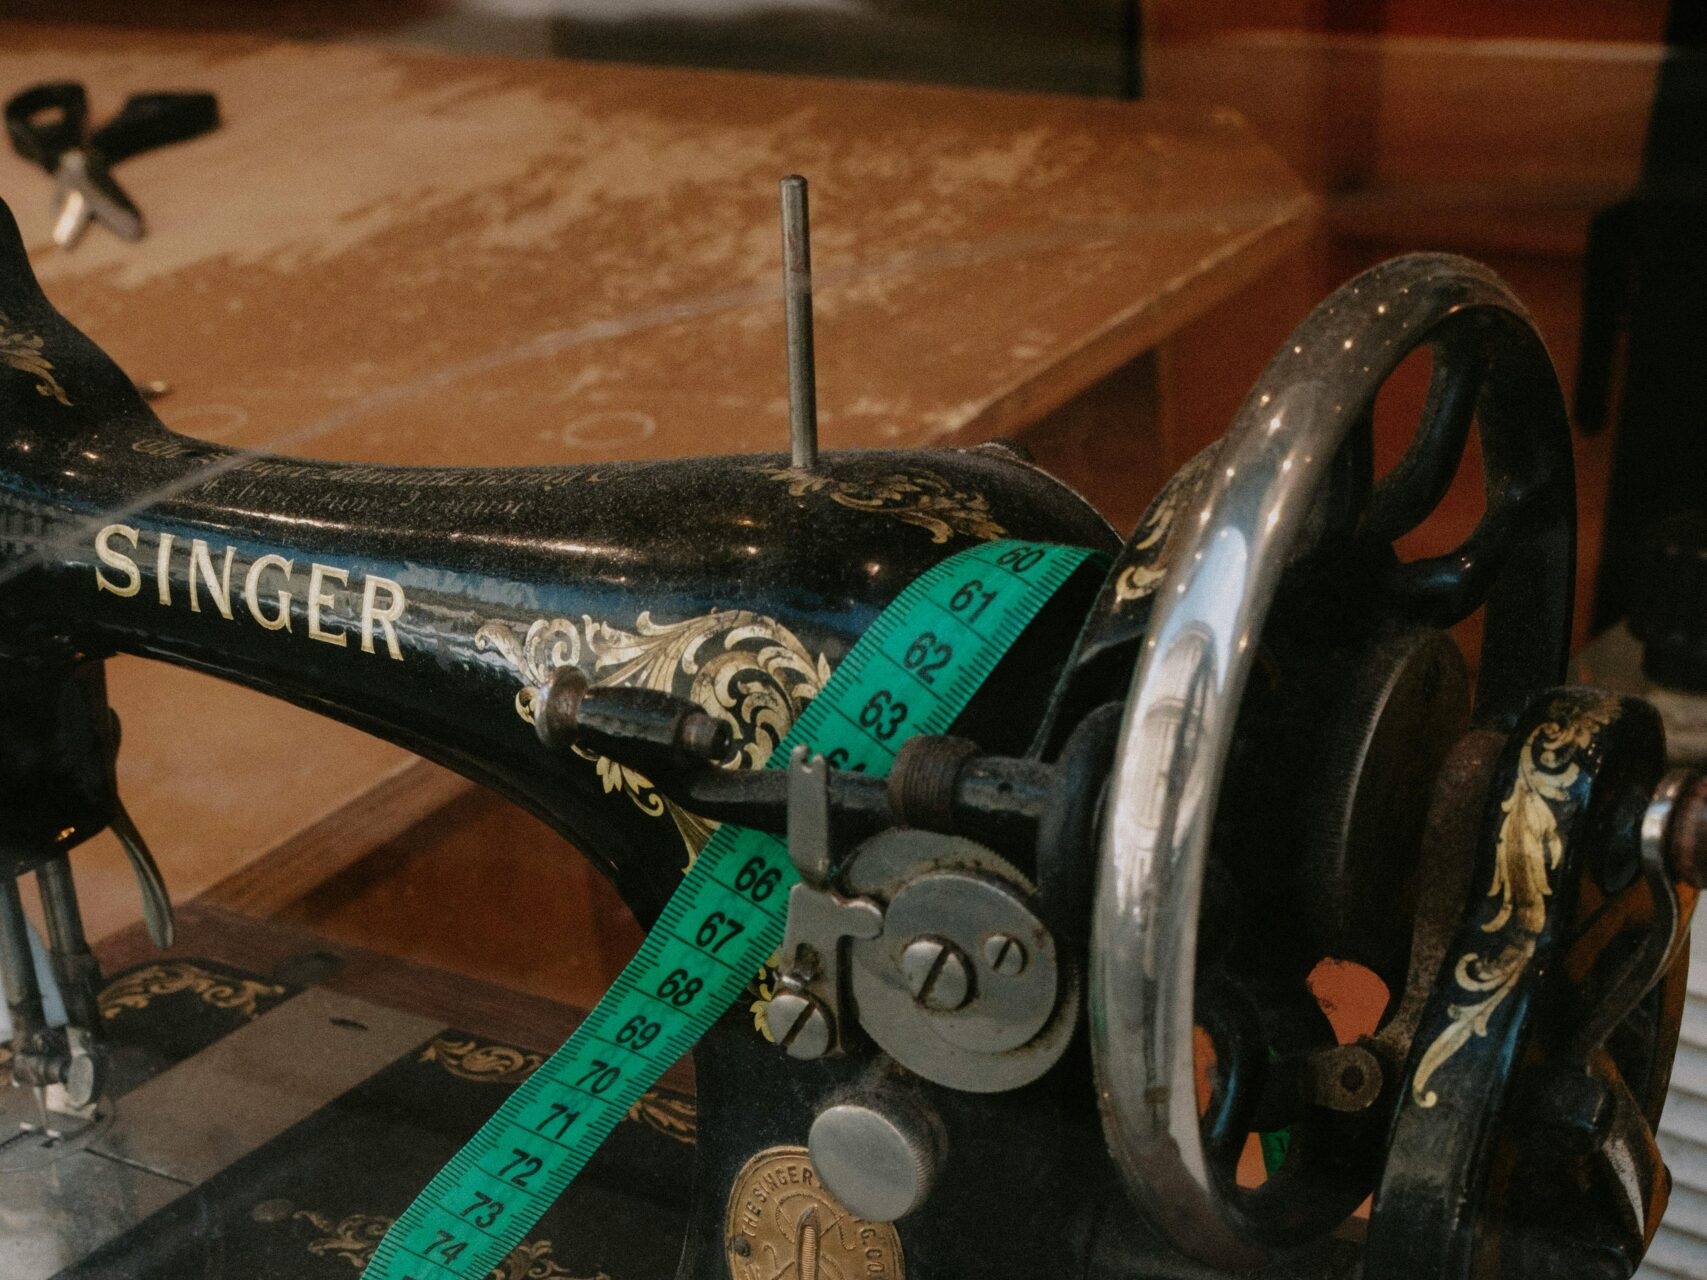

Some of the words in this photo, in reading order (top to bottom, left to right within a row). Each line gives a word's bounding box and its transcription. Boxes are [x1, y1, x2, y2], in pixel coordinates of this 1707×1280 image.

[996, 546, 1045, 573] 60
[95, 523, 405, 661] SINGER
[951, 580, 997, 625] 61
[903, 631, 952, 684] 62
[859, 690, 908, 740] 63
[734, 856, 782, 903] 66
[695, 911, 745, 953] 67
[656, 968, 704, 1007] 68
[615, 1015, 661, 1050] 69
[575, 1059, 621, 1094] 70
[536, 1103, 580, 1139] 71
[499, 1148, 543, 1187] 72
[752, 1165, 814, 1204] SINGER
[460, 1191, 505, 1228] 73
[423, 1230, 468, 1264] 74
